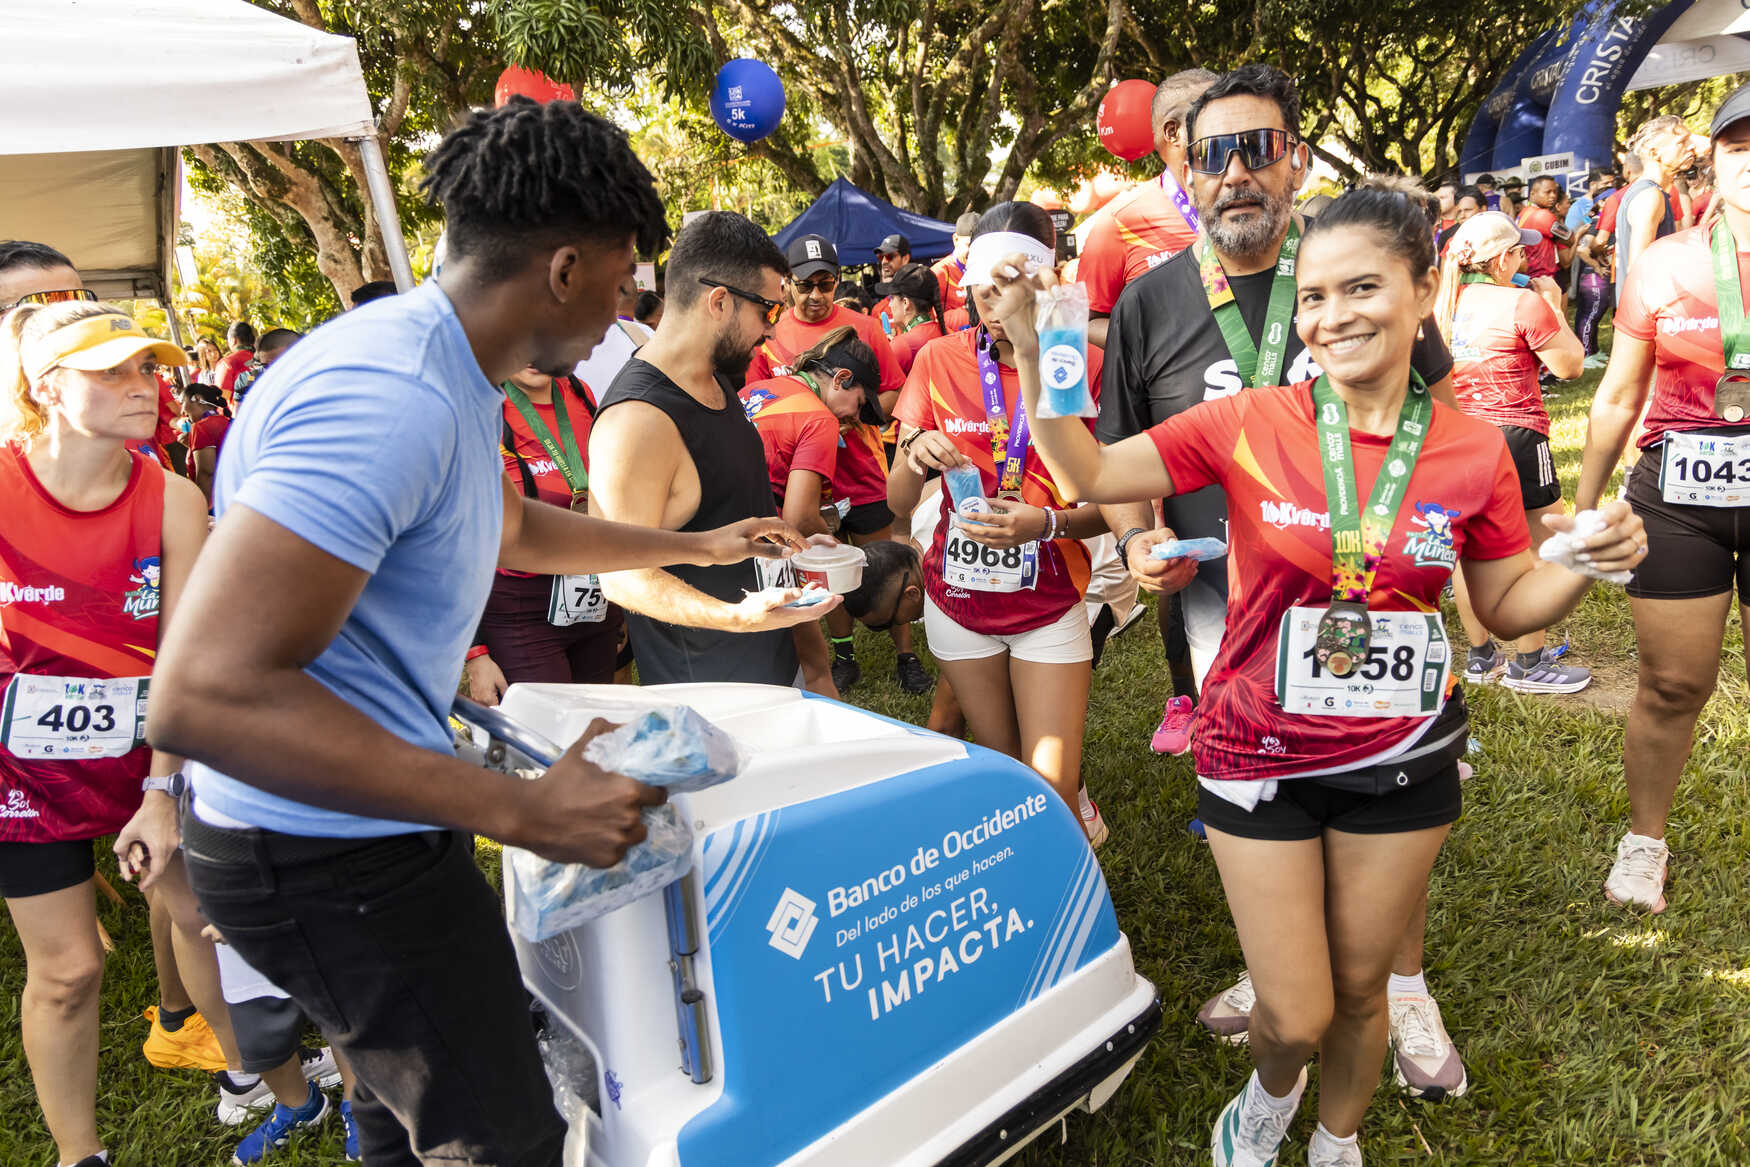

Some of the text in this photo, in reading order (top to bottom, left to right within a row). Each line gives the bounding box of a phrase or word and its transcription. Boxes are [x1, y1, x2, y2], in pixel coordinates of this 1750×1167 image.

[1576, 16, 1634, 104] CRISTA
[731, 108, 746, 120] 5k
[1007, 457, 1021, 473] 5K
[1675, 457, 1750, 484] 1043
[947, 537, 1021, 569] 4968
[1334, 530, 1362, 554] 10K
[574, 587, 606, 607] 75
[1303, 645, 1416, 681] 158
[37, 705, 116, 732] 403
[827, 793, 1048, 918] Banco de Occidente
[836, 844, 1015, 948] Del lado de los que hacen.
[814, 887, 999, 1003] TU HACER,
[868, 907, 1034, 1021] IMPACTA.
